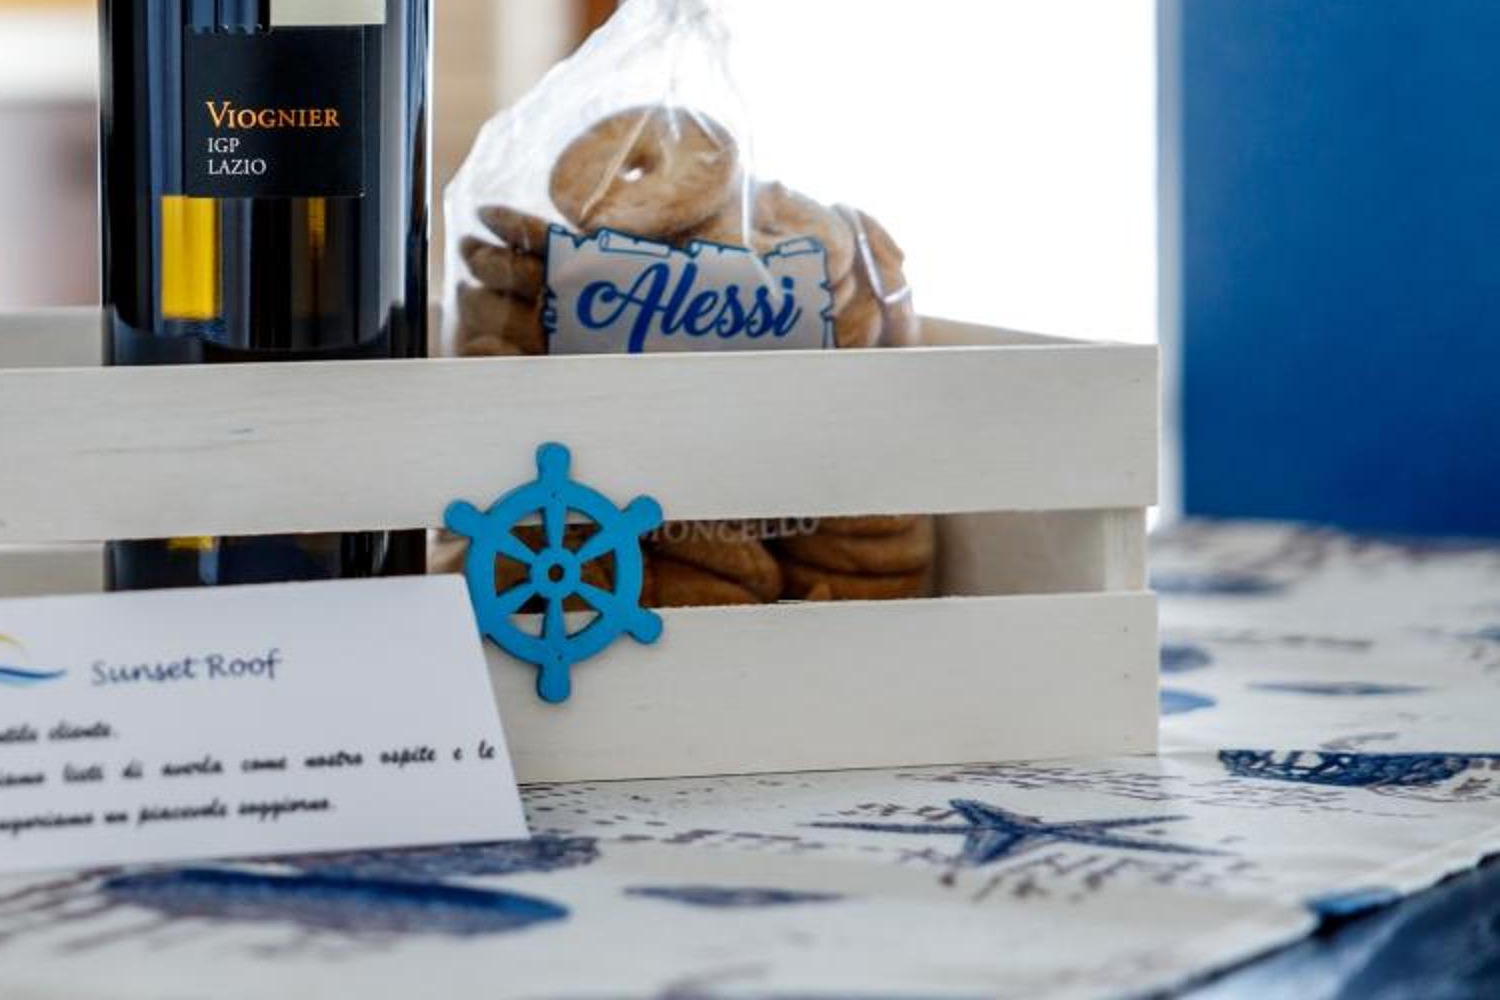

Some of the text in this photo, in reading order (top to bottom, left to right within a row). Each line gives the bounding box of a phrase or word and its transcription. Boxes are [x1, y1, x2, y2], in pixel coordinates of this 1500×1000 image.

[205, 101, 340, 128] VIOGNIER
[207, 137, 240, 153] IGP
[208, 159, 267, 176] LAZIO
[576, 262, 803, 353] Alessi
[650, 516, 820, 542] ONCELLO
[91, 648, 282, 686] Sunset Roof
[380, 746, 436, 768] ospite
[453, 747, 463, 761] e
[478, 739, 495, 760] le
